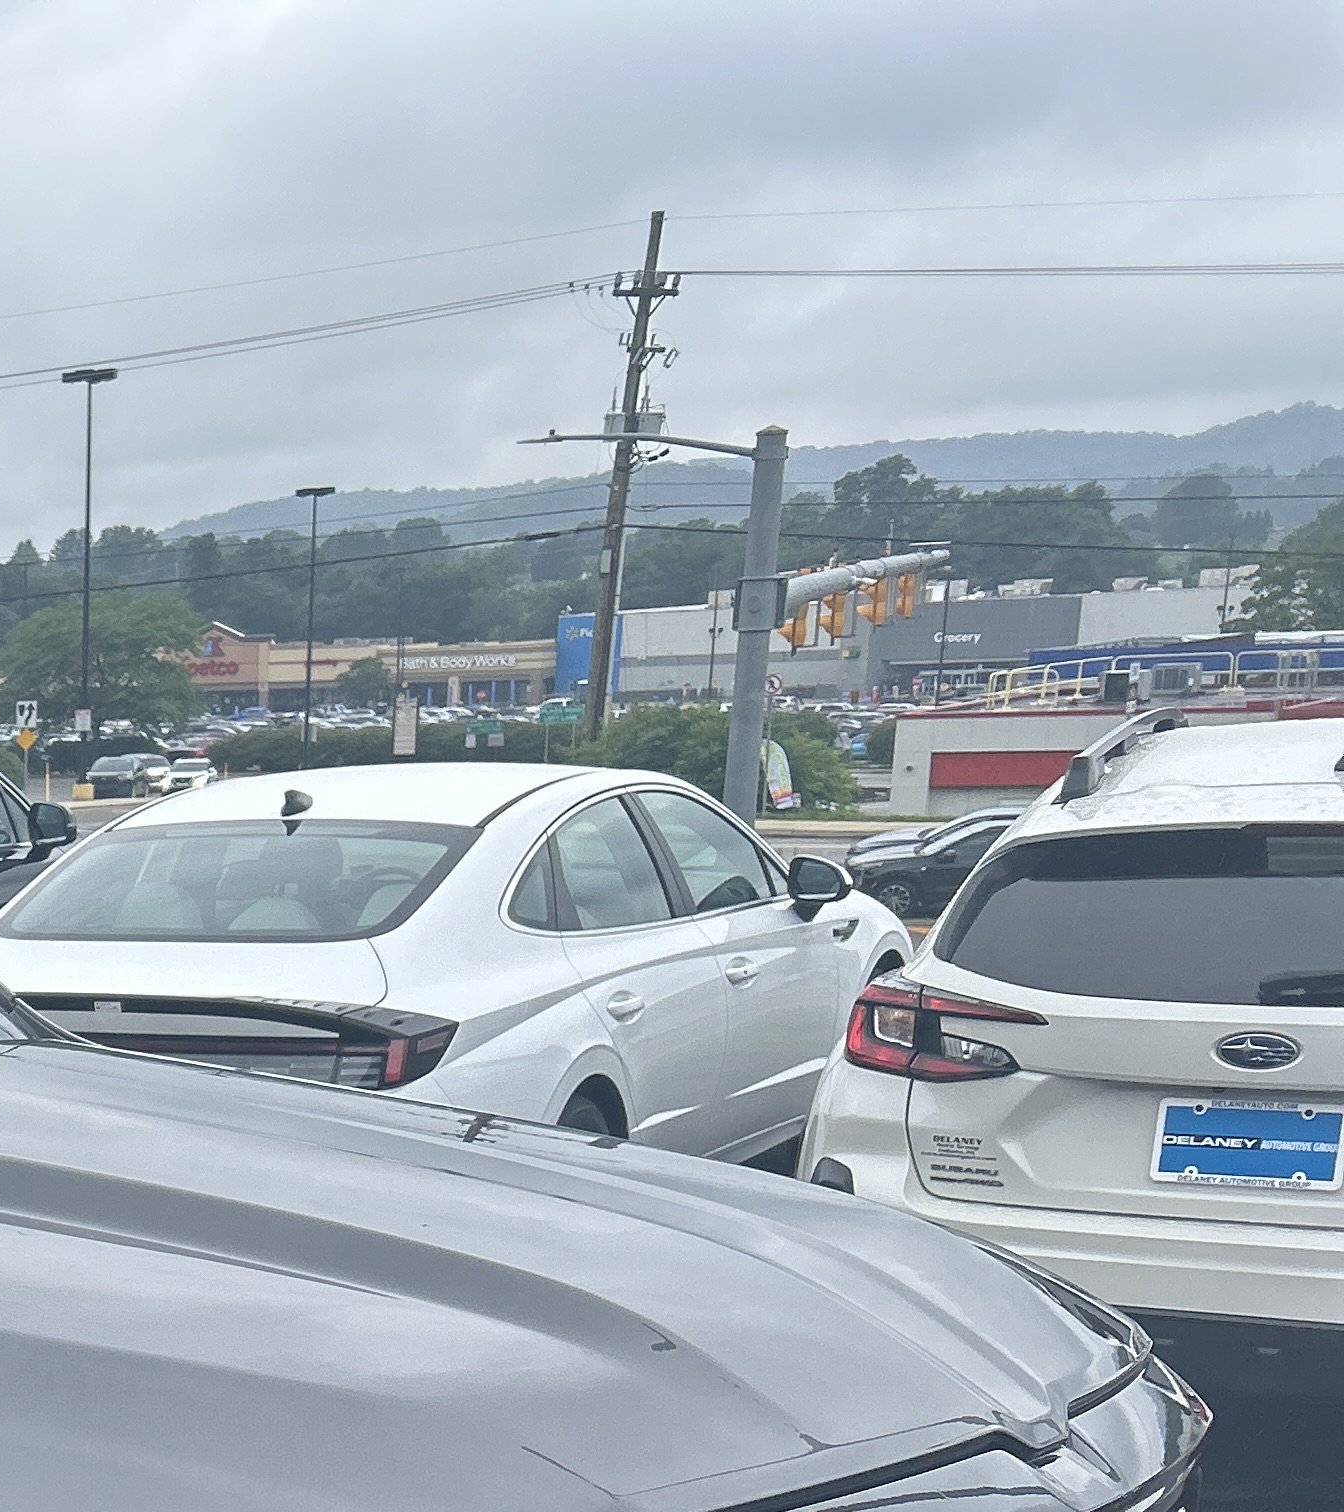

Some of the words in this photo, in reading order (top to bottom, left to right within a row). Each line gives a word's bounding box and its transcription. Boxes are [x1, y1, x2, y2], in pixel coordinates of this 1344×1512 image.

[934, 632, 982, 644] Grocery
[440, 656, 472, 670] Body
[474, 655, 517, 667] Works
[933, 1135, 983, 1145] DELANEY
[1163, 1135, 1258, 1149] DELANEY
[931, 1164, 999, 1177] SUBARU
[1177, 1174, 1217, 1184] DELANEY
[1219, 1177, 1276, 1187] AUTOMOTIVE
